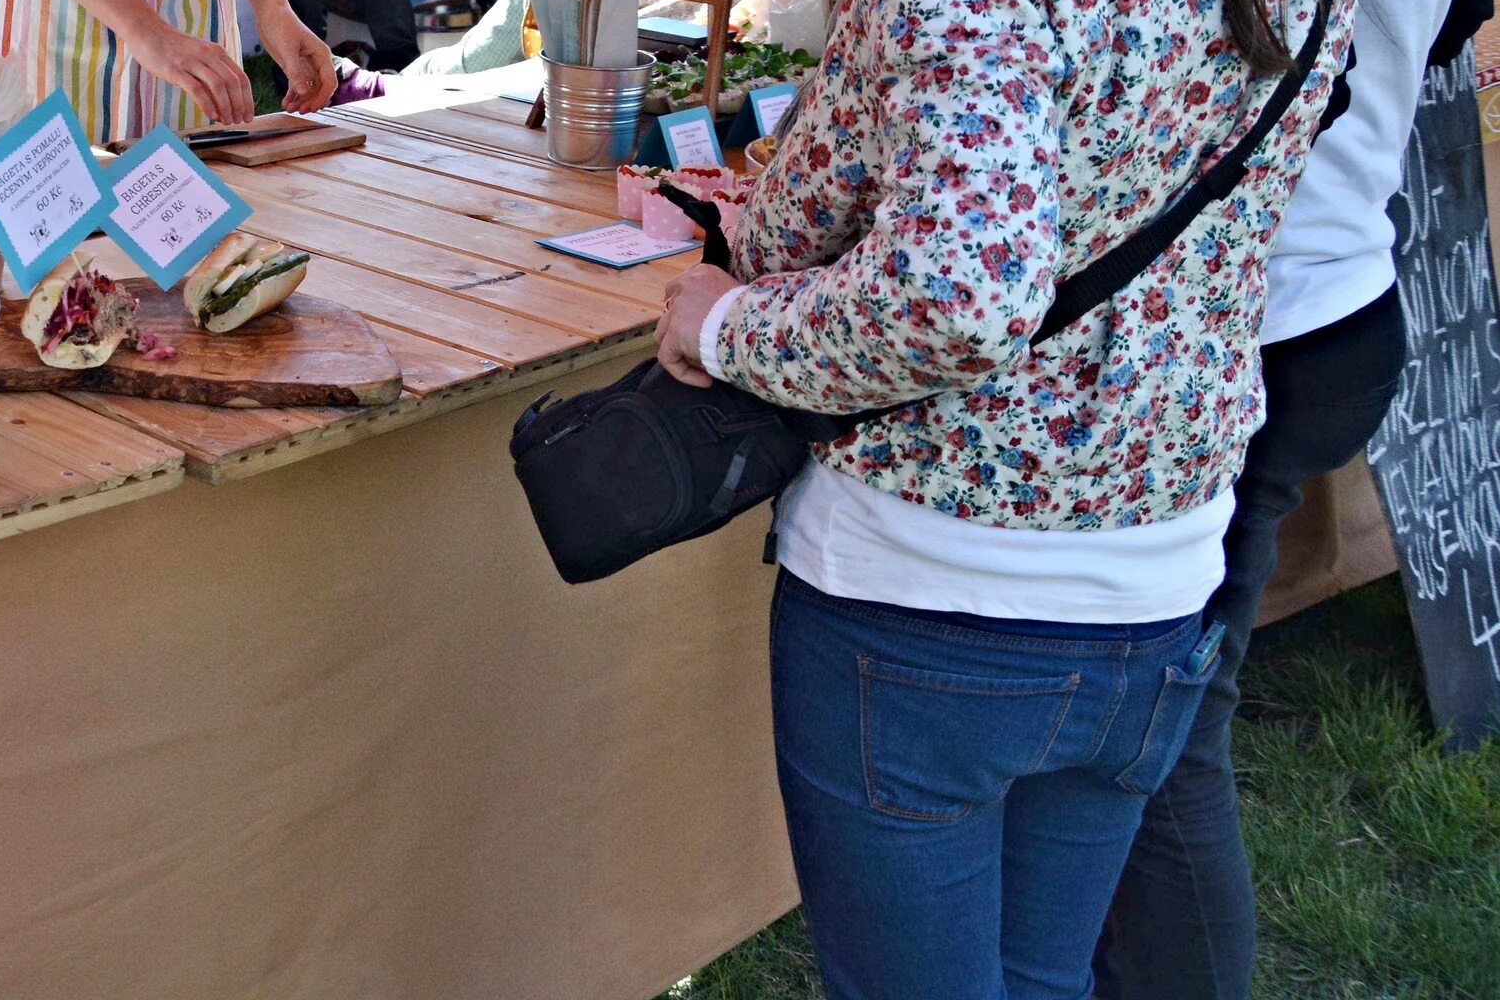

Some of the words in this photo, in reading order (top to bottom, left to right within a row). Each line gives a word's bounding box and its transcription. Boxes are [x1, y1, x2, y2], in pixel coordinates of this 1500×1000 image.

[24, 154, 33, 165] S
[31, 127, 61, 159] POMALU
[35, 195, 51, 212] 60
[51, 185, 63, 201] Kč
[120, 170, 158, 203] BAGETA
[154, 163, 165, 174] S
[130, 172, 179, 216] CHŘESTEM
[160, 208, 175, 224] 60
[174, 199, 186, 214] Kč
